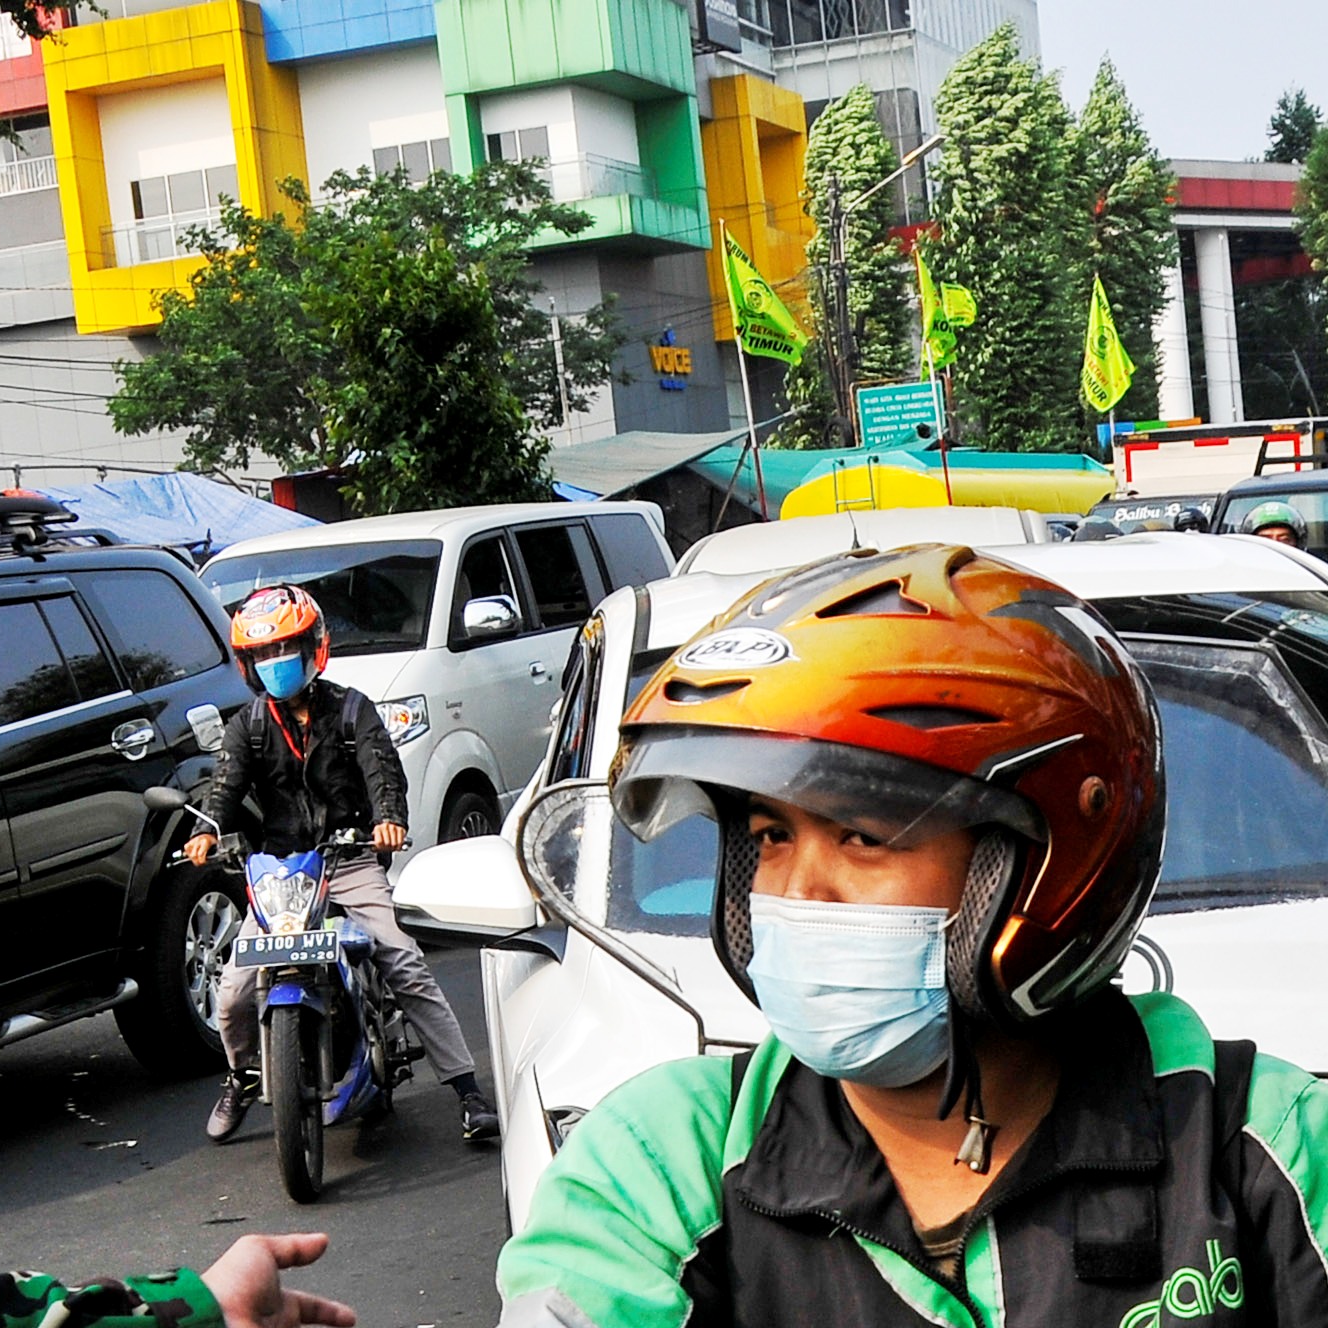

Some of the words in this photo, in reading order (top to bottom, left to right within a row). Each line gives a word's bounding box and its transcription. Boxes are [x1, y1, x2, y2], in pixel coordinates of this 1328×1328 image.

[748, 335, 793, 355] TIMUR
[237, 940, 248, 953] B
[255, 936, 294, 952] 6100
[303, 933, 335, 948] WVT
